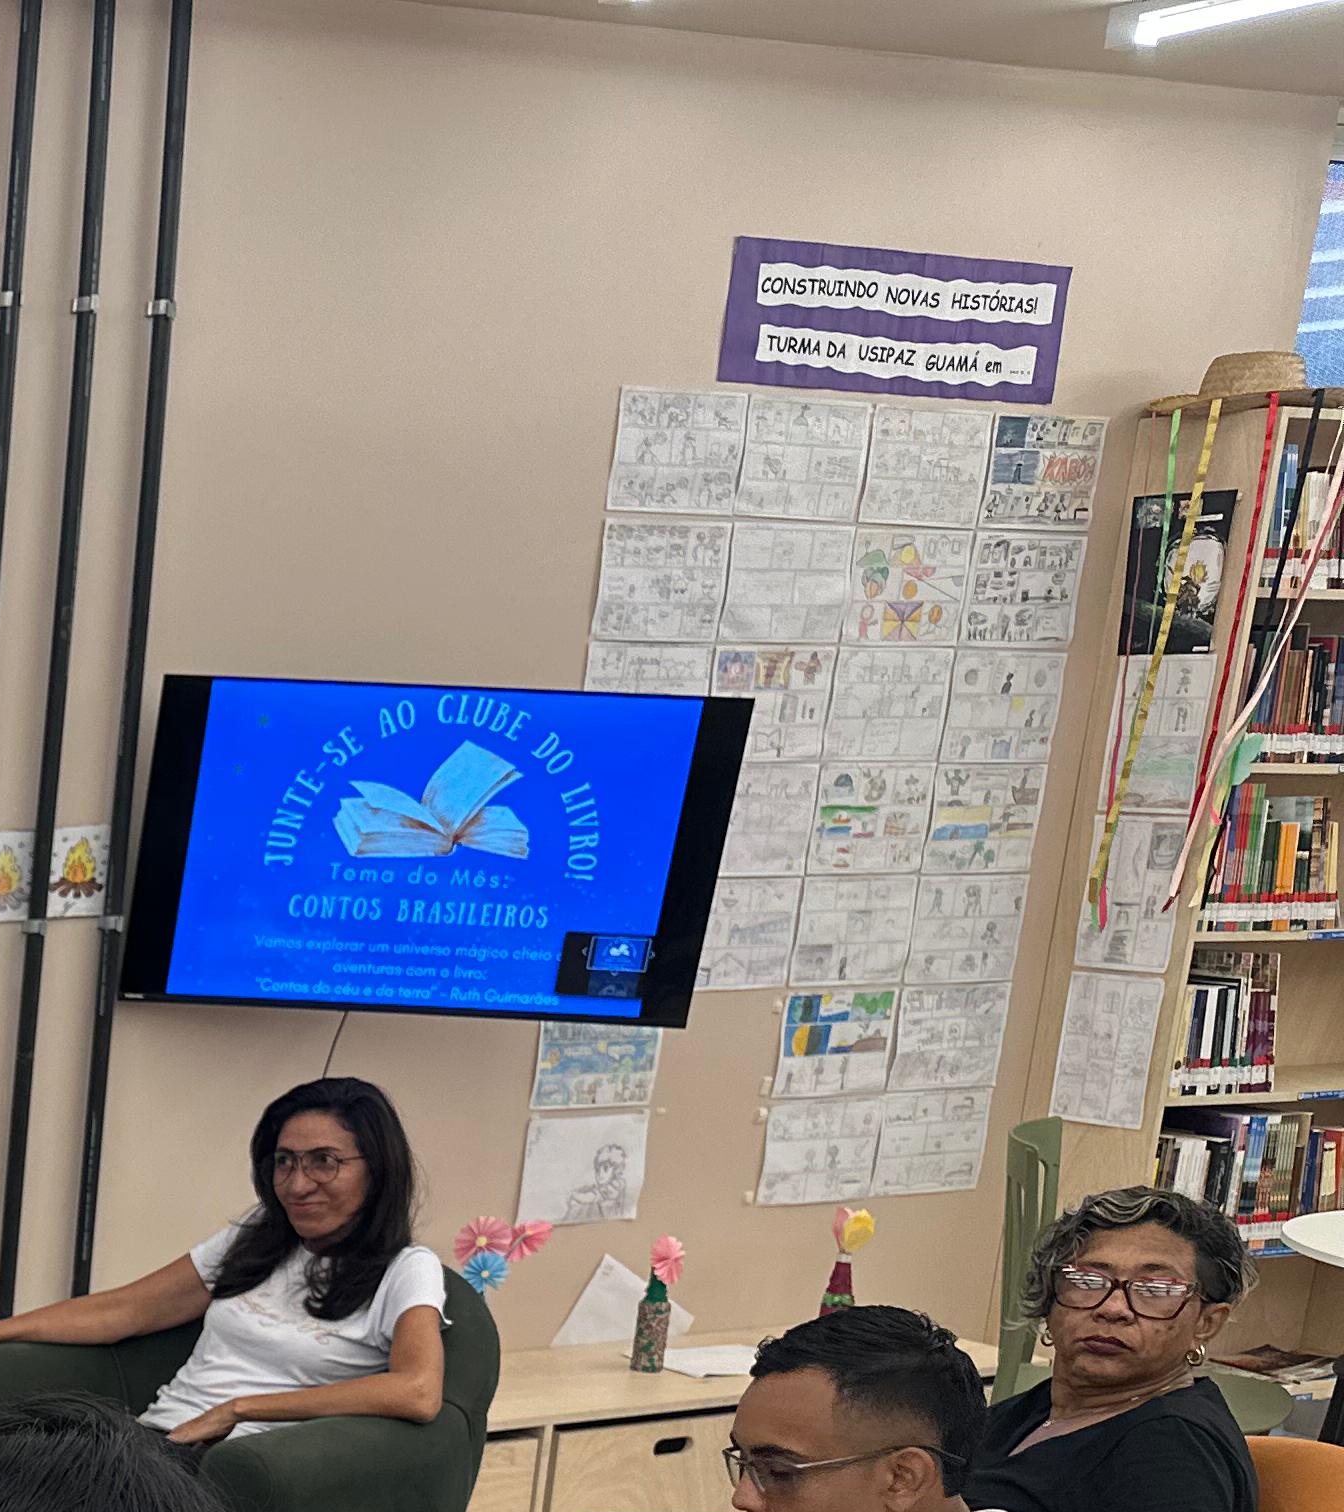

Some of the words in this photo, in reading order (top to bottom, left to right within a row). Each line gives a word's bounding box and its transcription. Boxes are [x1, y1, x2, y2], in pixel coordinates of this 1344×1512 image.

[761, 276, 879, 298] CONSTRUINDO
[885, 286, 941, 308] NOVAS
[951, 289, 1039, 315] HISTÓRIAS!
[766, 334, 821, 356] TURMA
[826, 340, 847, 359] DA
[858, 343, 917, 367] USIPAZ
[925, 350, 980, 372] GUAMÁ
[985, 360, 1003, 374] em
[263, 725, 365, 867] JUNTE-SE
[378, 699, 416, 739] AO
[436, 693, 533, 742] CLUBE
[530, 731, 574, 776] DO
[560, 781, 601, 882] LIVRO!
[329, 862, 395, 885] Tema
[408, 864, 439, 886] do
[288, 893, 382, 921] CONTOS
[396, 898, 550, 930] BRASILEIROS
[254, 934, 303, 950] Vamos
[306, 936, 364, 955] explorar
[367, 941, 391, 954] um
[393, 940, 452, 957] universo
[455, 943, 509, 962] mágico
[512, 945, 553, 962] cheio
[332, 961, 403, 977] aventuras
[405, 965, 438, 978] com
[312, 979, 331, 995] do
[334, 980, 360, 997] céu
[375, 983, 395, 999] da
[450, 986, 481, 1003] Ruth
[484, 989, 560, 1008] Guimarães
